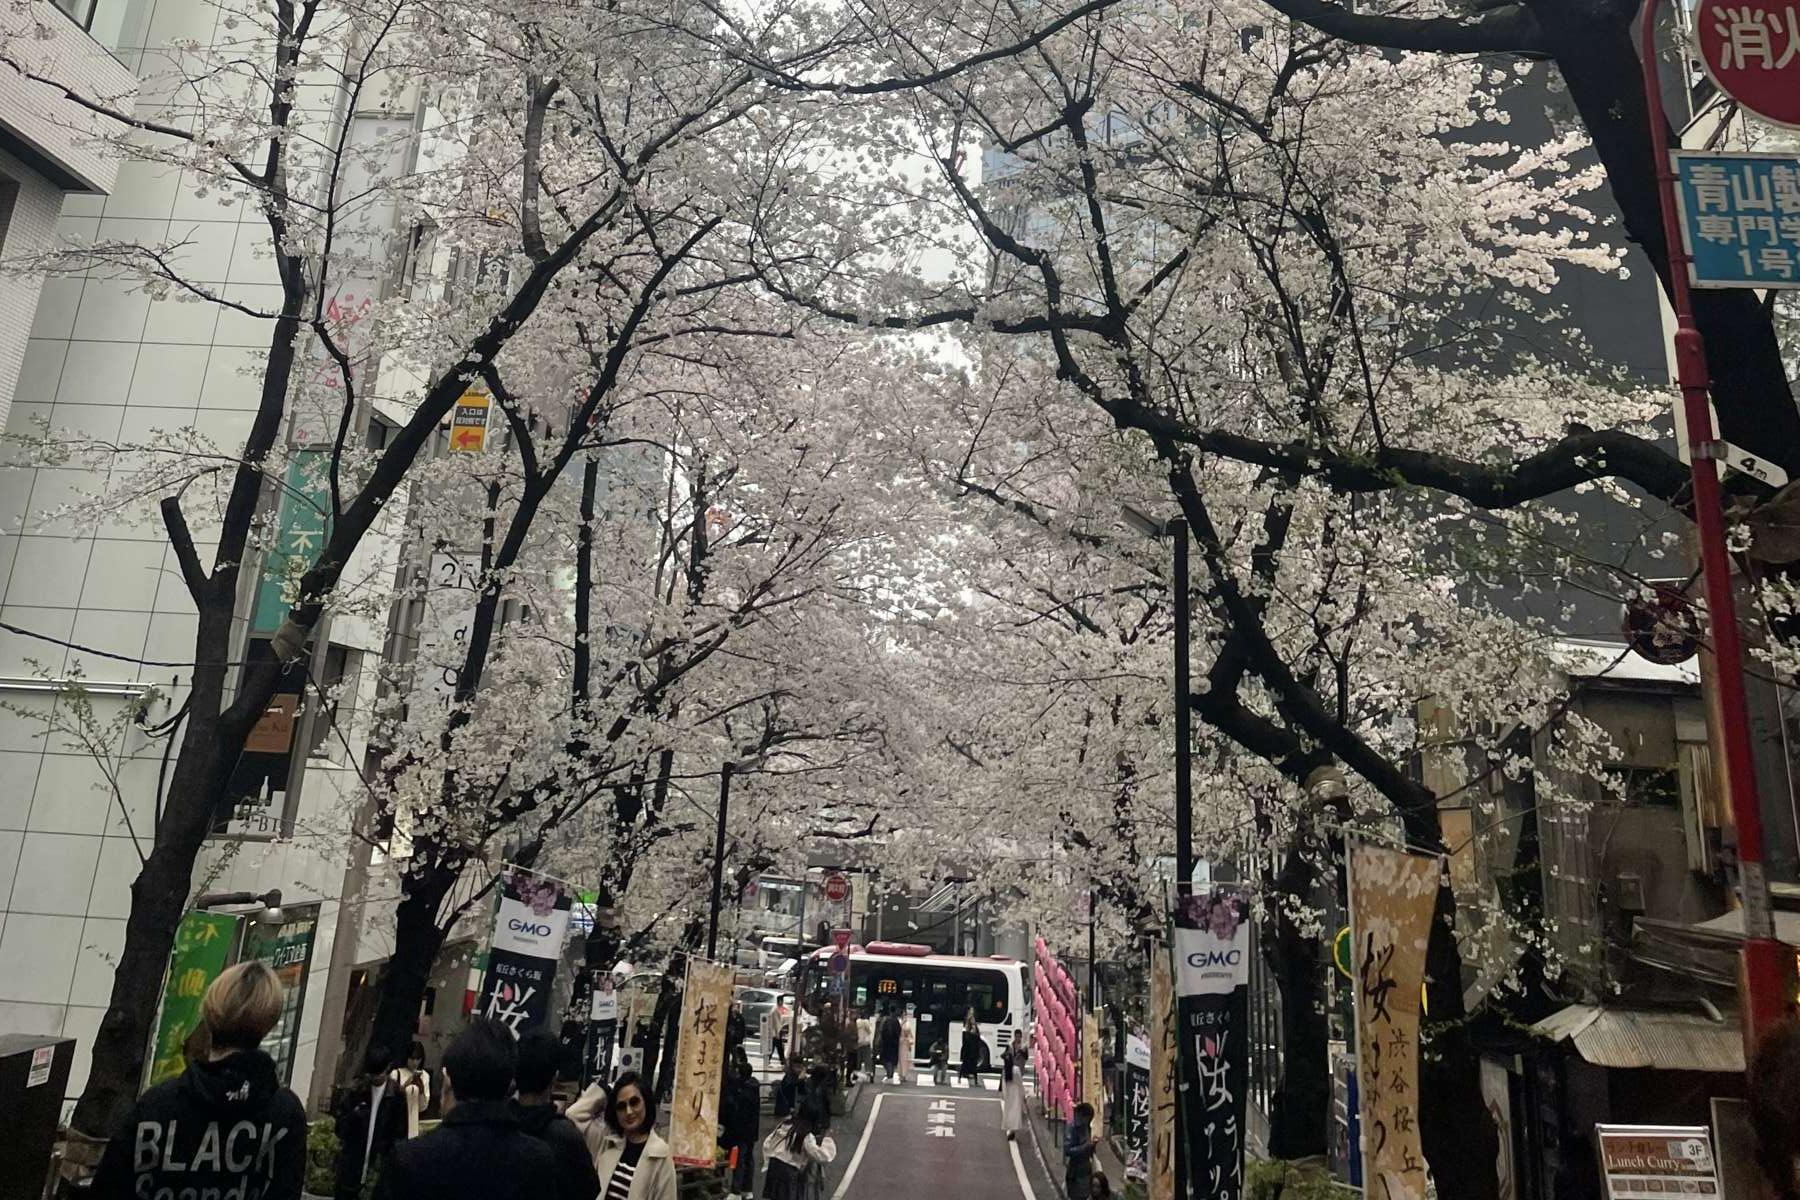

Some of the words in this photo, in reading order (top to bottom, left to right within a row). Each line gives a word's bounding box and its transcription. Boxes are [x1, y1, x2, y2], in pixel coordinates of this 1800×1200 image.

[508, 918, 551, 937] GMO
[693, 997, 718, 1121] 桜まつり
[1388, 1028, 1423, 1174] 渋谷桜丘
[134, 1119, 289, 1179] BLACK
[1608, 1153, 1645, 1169] Lunch
[1647, 1155, 1680, 1171] Curry
[1688, 1144, 1703, 1156] 3F
